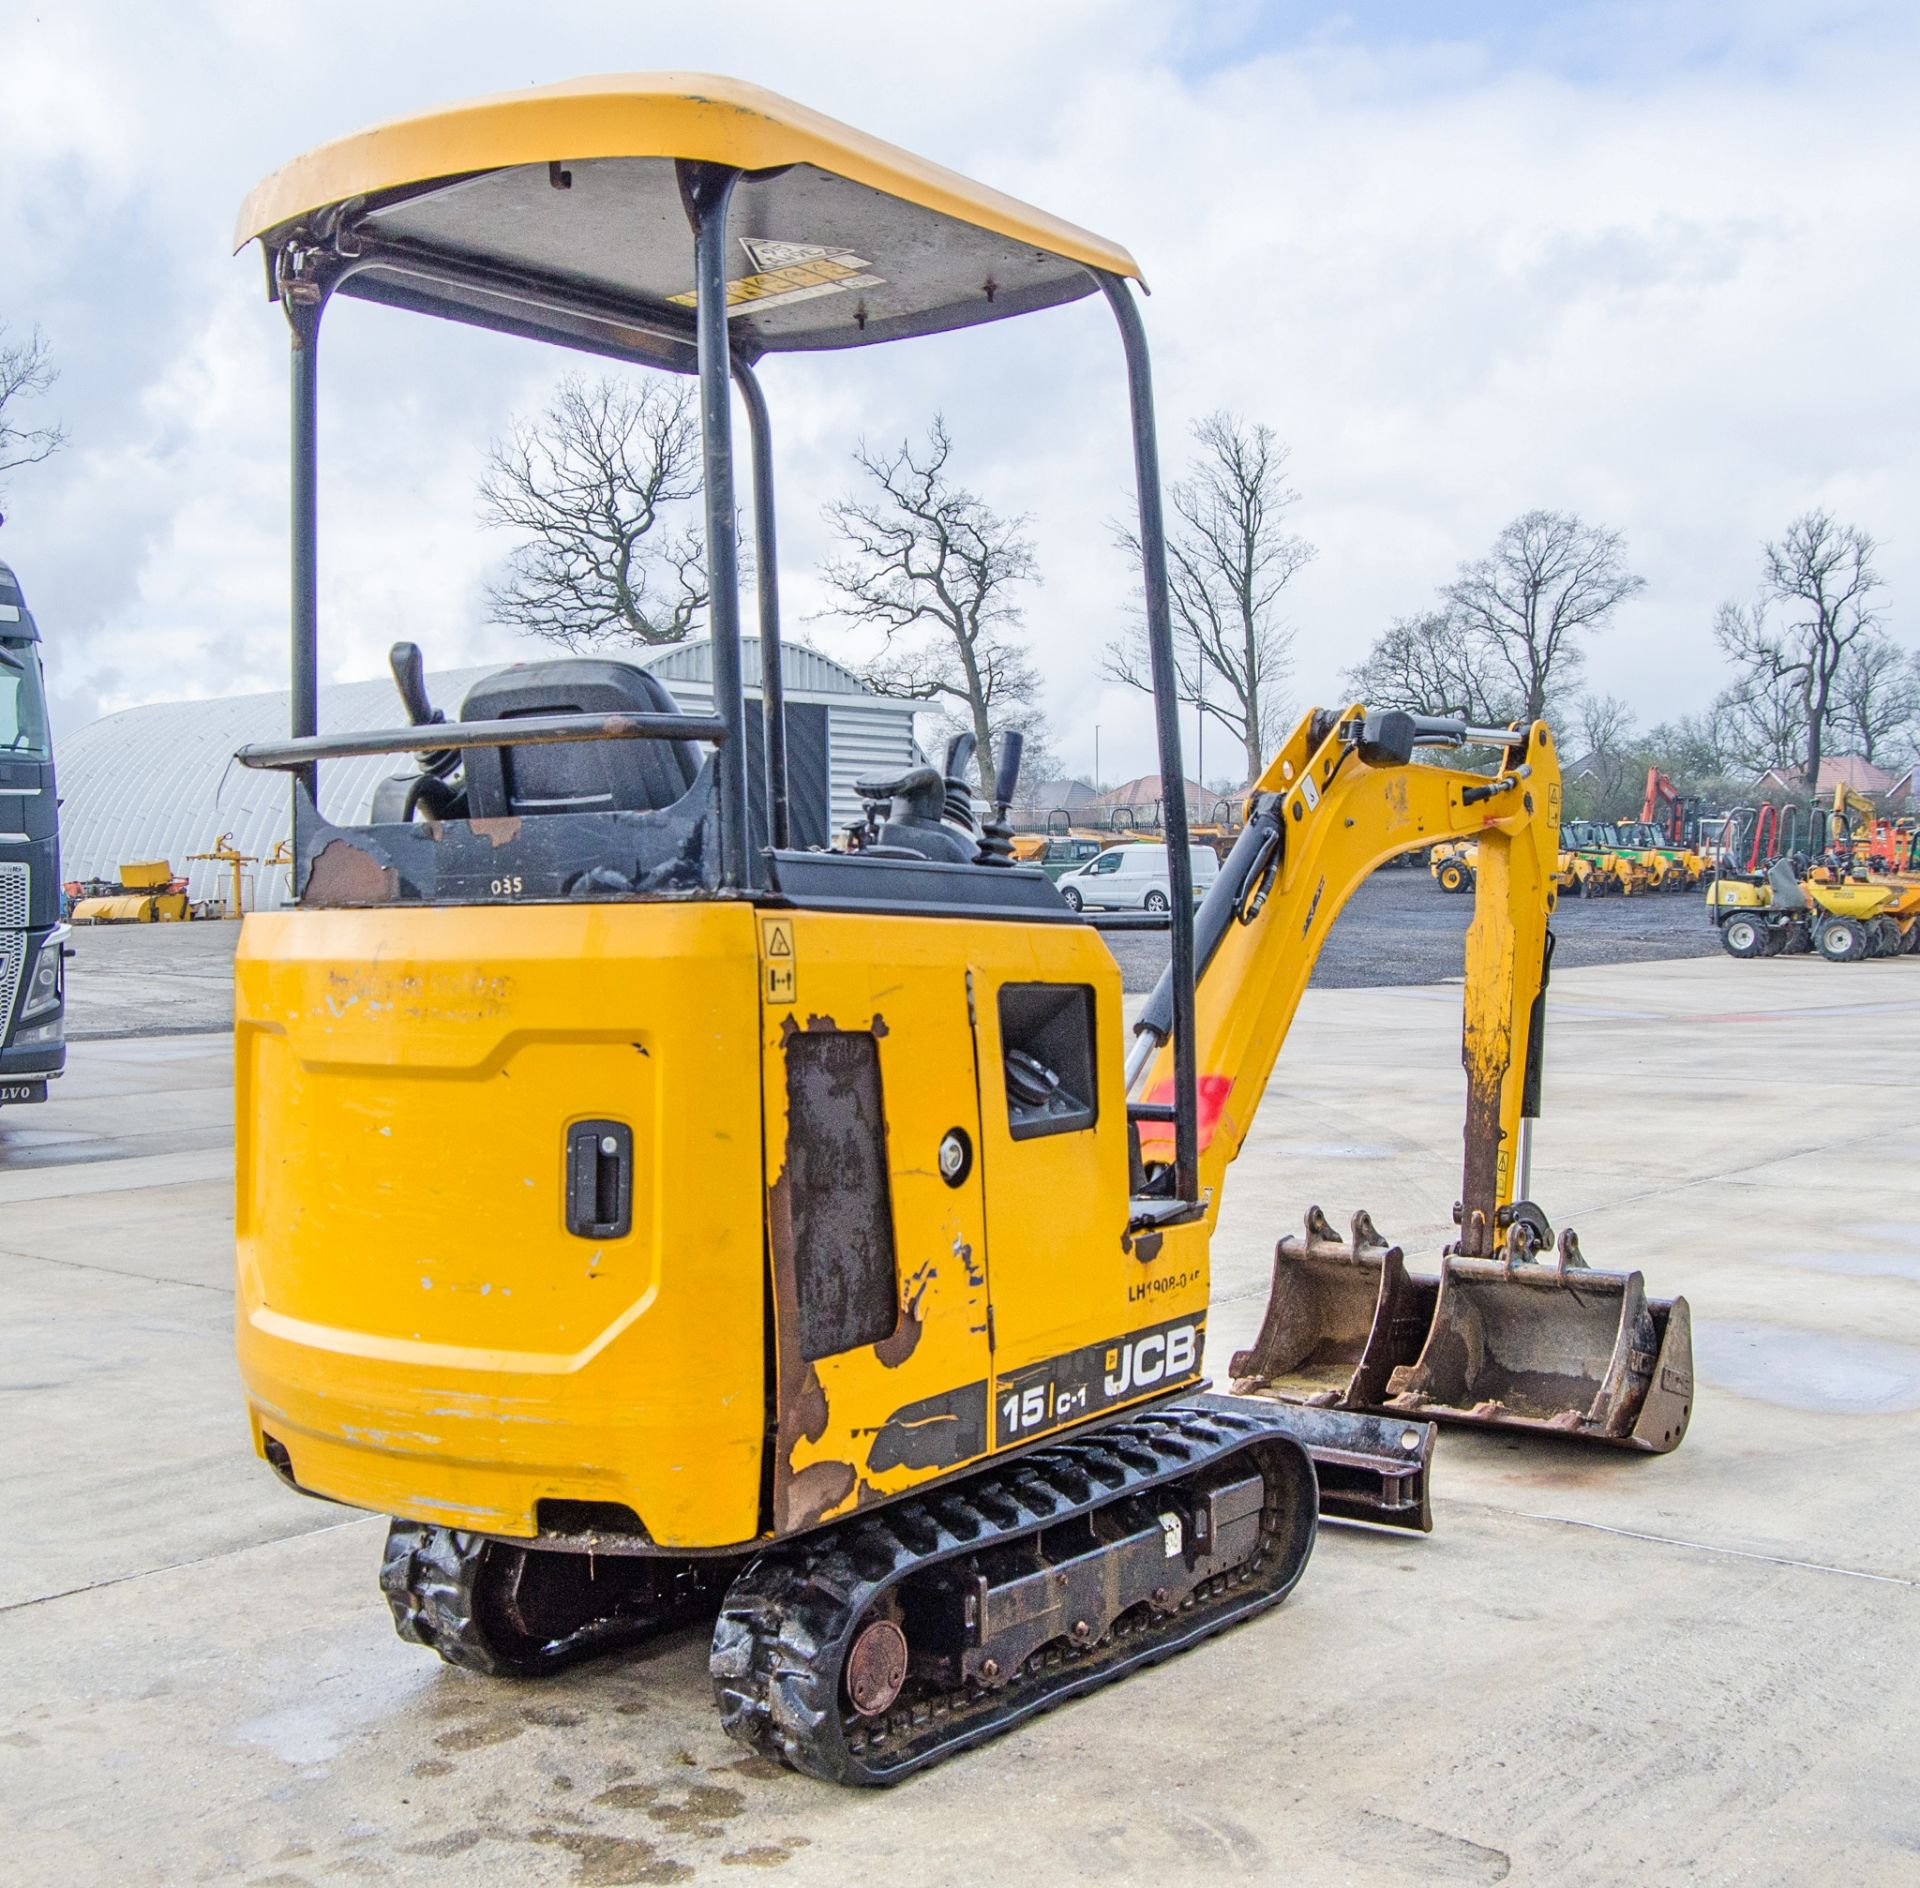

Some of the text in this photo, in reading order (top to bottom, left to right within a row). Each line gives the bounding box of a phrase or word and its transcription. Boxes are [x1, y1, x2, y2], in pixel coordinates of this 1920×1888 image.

[491, 876, 522, 894] 035
[1104, 1325, 1196, 1397] JCB
[1003, 1385, 1044, 1433] 15
